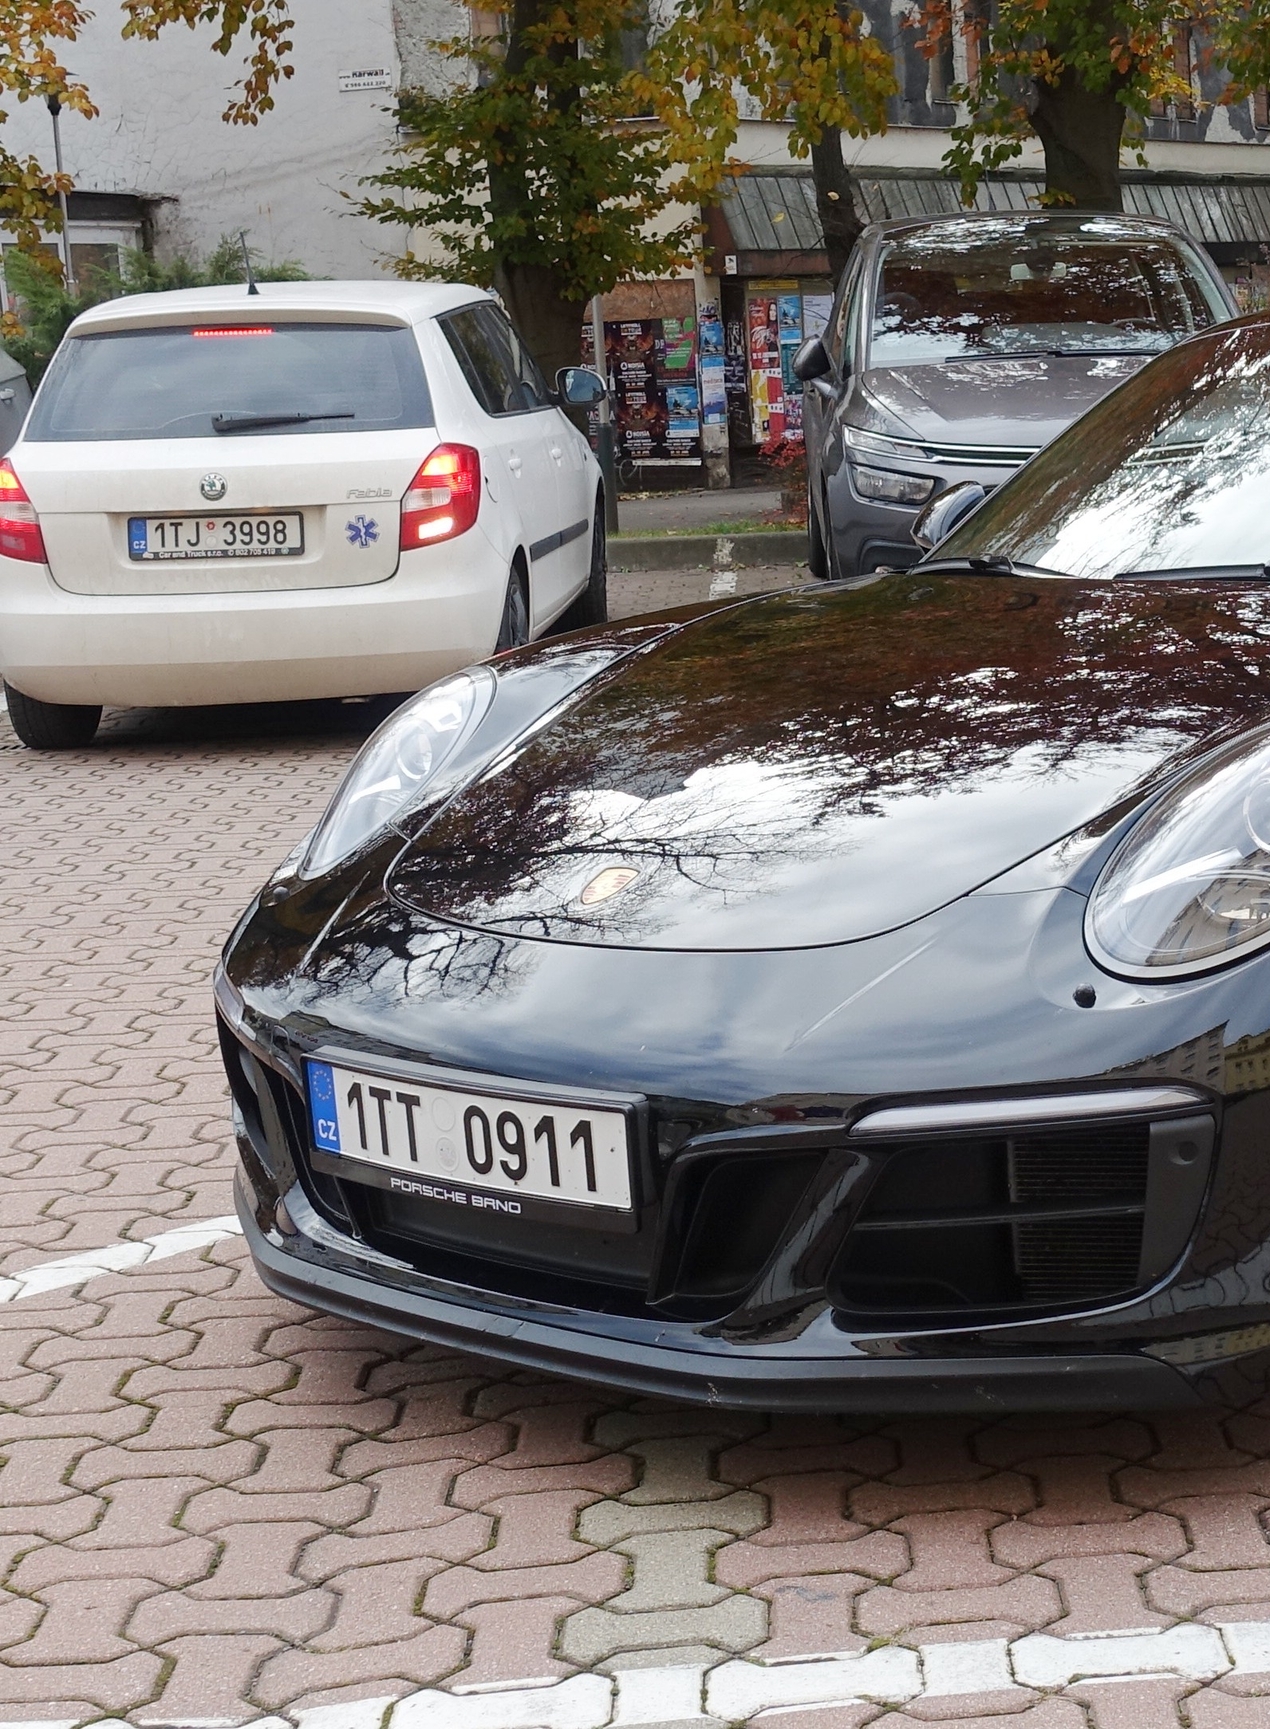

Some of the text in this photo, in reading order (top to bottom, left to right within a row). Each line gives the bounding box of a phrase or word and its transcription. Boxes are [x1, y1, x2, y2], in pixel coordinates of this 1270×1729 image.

[346, 488, 393, 499] Fabia
[133, 540, 146, 549] CZ
[155, 520, 287, 548] 1TJ 3998
[318, 1119, 337, 1141] CZ
[347, 1082, 597, 1192] 1TT 0911
[389, 1177, 521, 1214] PORSCHE BRNO
